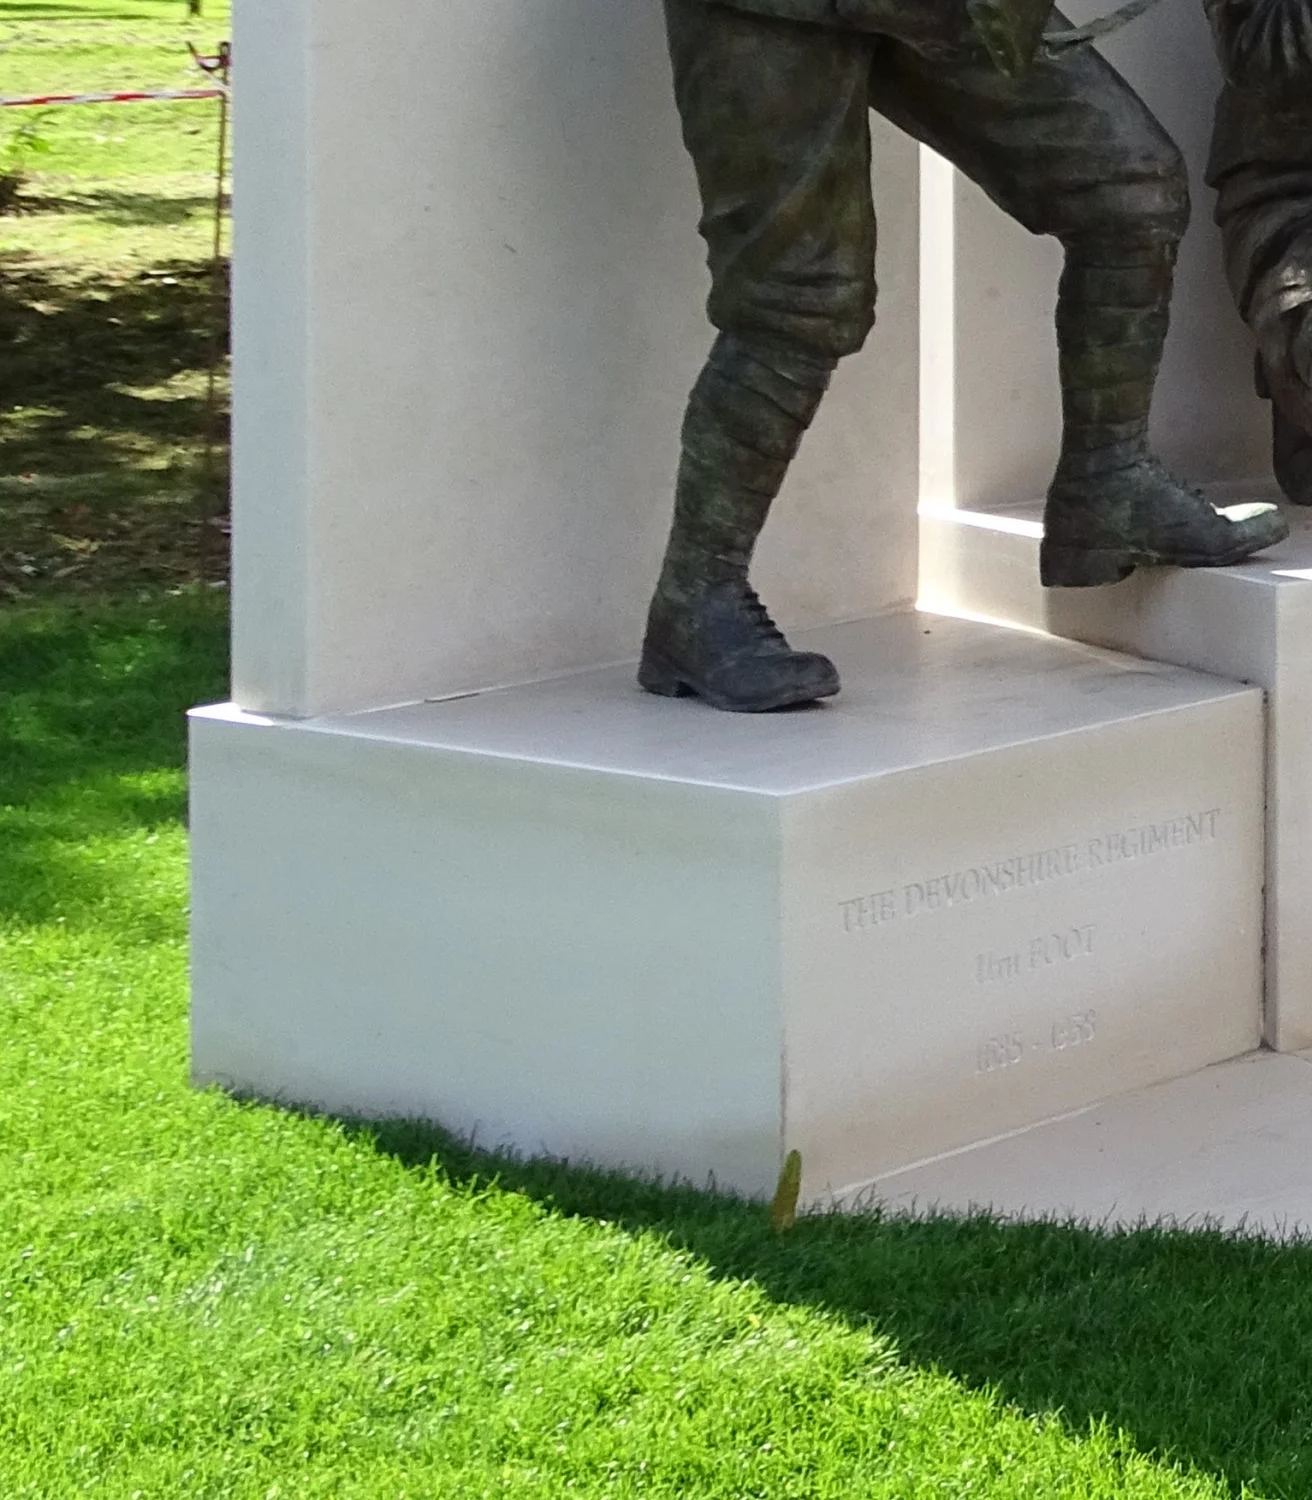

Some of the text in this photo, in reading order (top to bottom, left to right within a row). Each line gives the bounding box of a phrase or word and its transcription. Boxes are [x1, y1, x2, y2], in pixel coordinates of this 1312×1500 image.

[838, 807, 1222, 933] THE DEVONSHIRE REGIMENT
